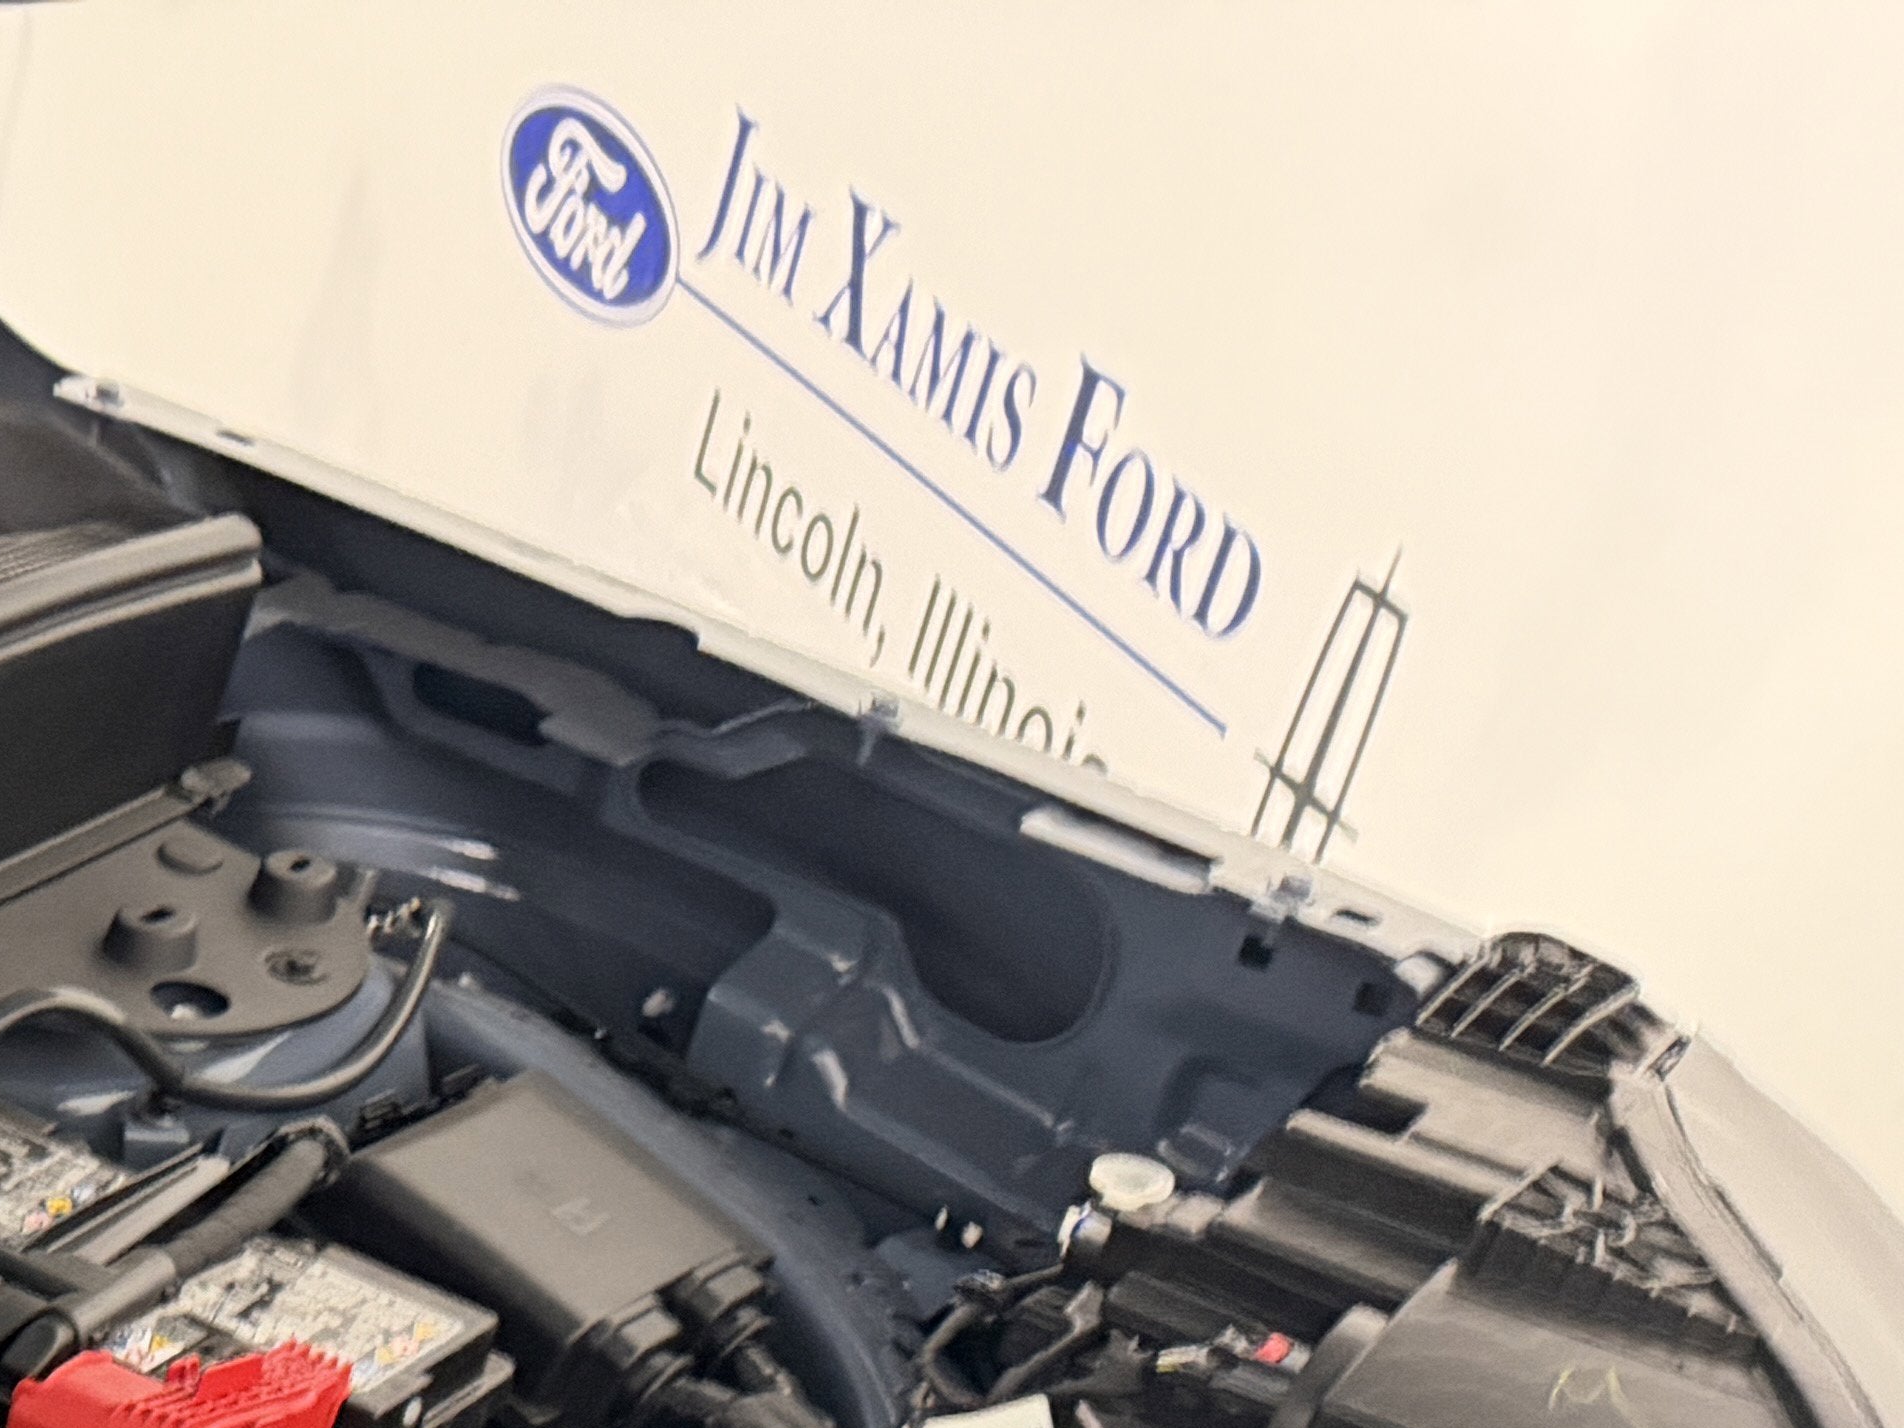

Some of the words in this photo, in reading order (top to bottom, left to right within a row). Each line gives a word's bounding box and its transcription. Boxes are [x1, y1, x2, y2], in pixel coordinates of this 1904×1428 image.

[521, 114, 649, 303] Ford
[697, 103, 818, 307] JIM
[813, 183, 1038, 474] XAMIS
[1037, 350, 1264, 642] FORD
[694, 387, 886, 668] Lincoln,
[908, 573, 1109, 774] Illinoi
